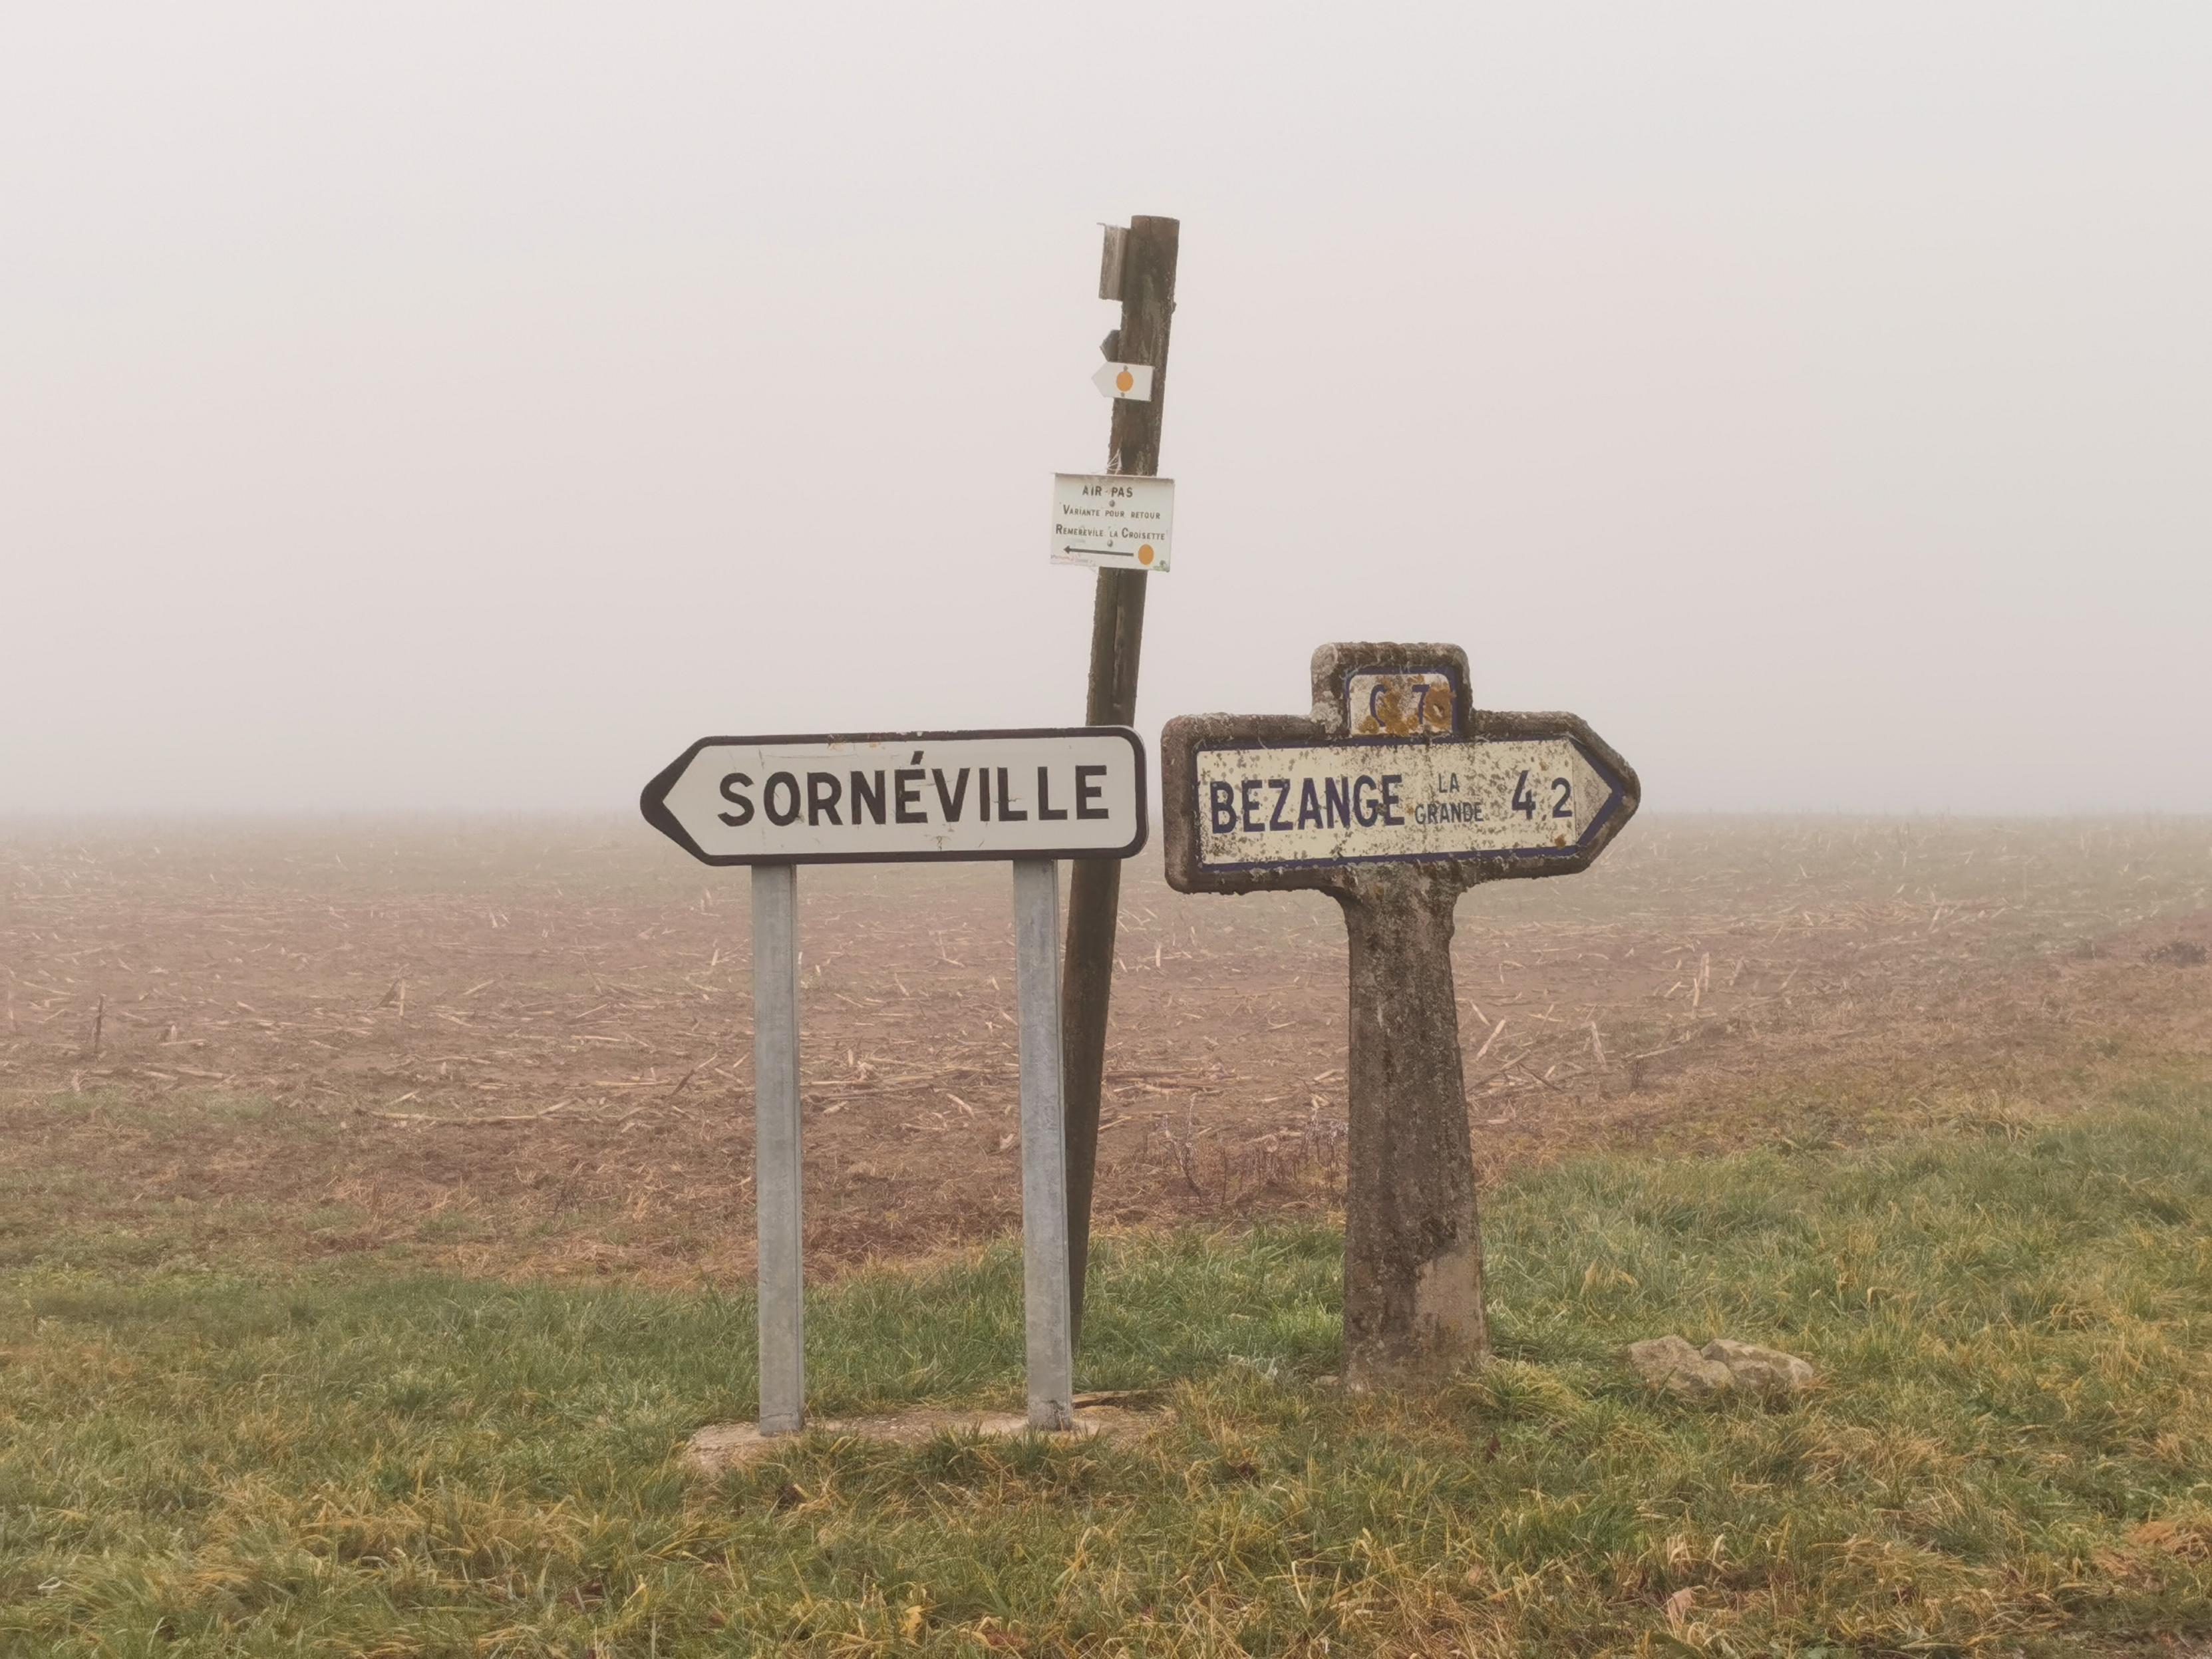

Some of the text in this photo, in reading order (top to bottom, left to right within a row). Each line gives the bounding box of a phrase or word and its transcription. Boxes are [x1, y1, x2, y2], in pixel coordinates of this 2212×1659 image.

[1082, 485, 1134, 498] AIR PAS
[1062, 504, 1100, 517] VARIANTE
[1130, 511, 1161, 520] RETOUR
[1121, 527, 1166, 540] CROISETTE
[718, 750, 1110, 827] SORNÉVILLE
[1438, 772, 1460, 794] LA
[1209, 774, 1405, 834] BEZANGE
[1414, 802, 1484, 825] GRANDE
